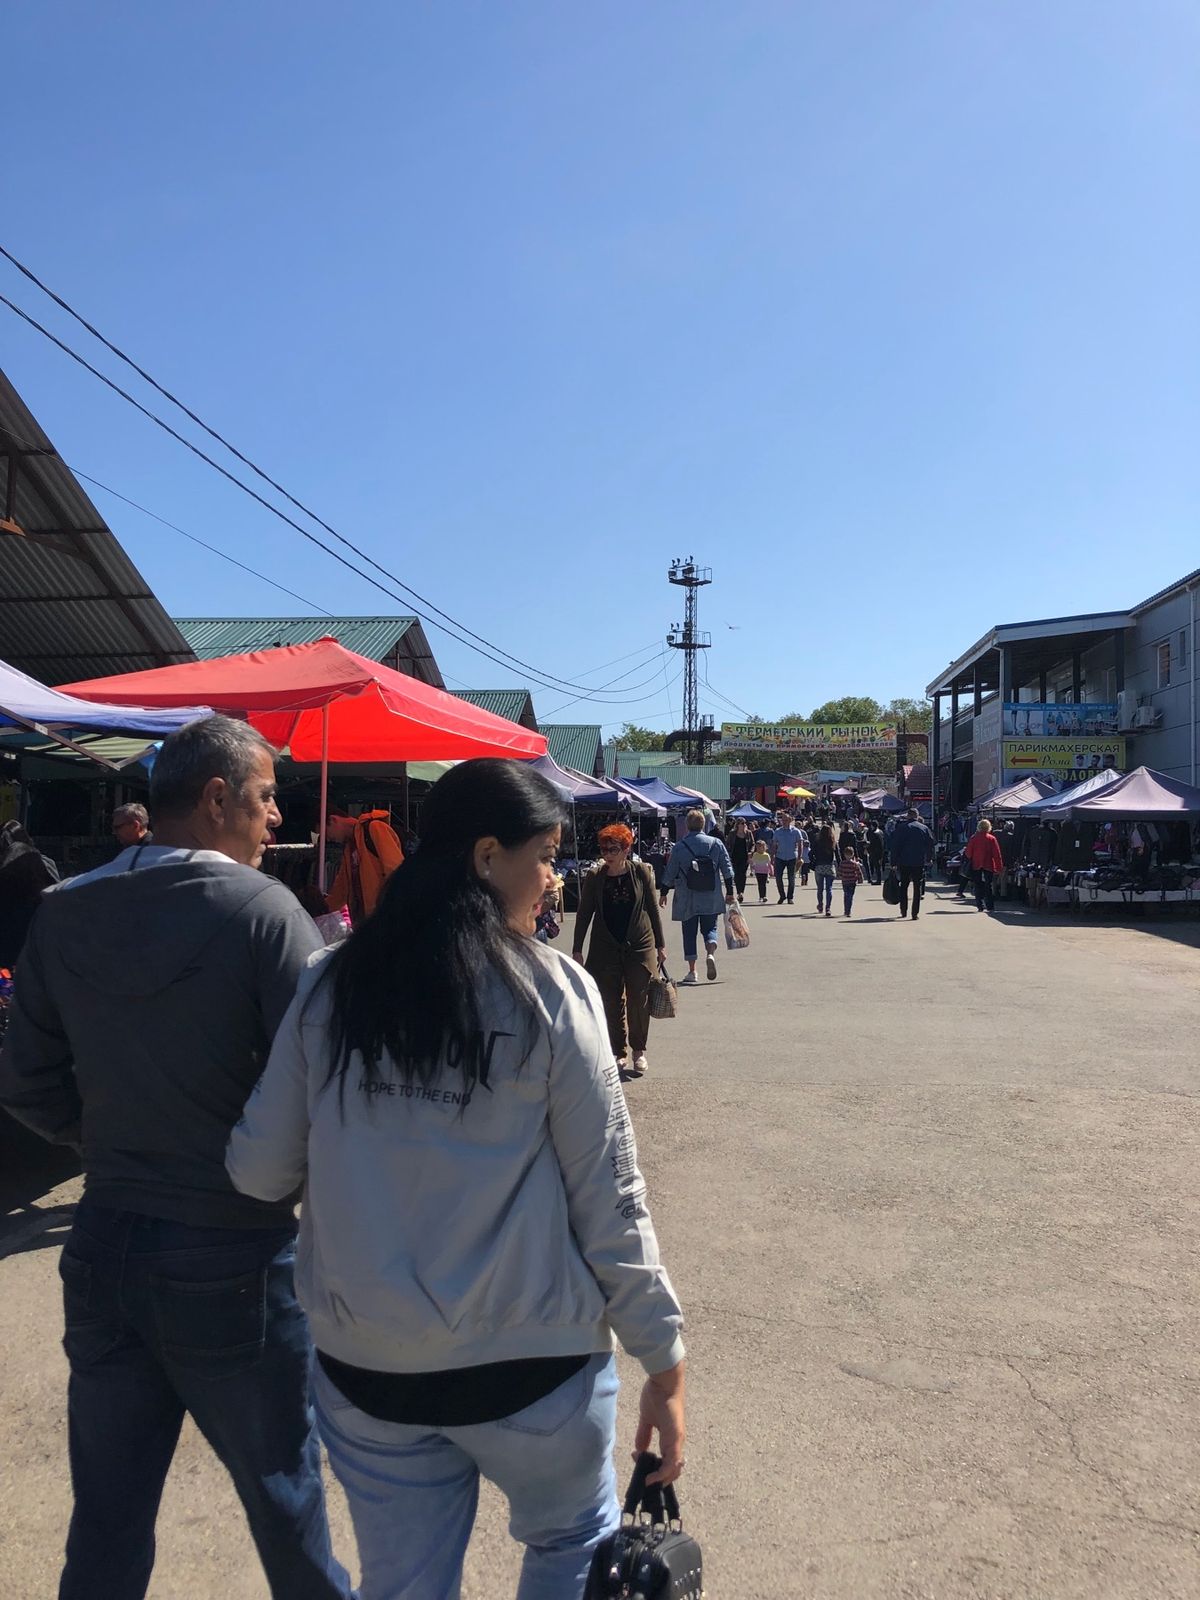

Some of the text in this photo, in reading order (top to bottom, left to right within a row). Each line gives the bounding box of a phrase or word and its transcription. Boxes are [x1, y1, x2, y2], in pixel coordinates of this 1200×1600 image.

[735, 726, 879, 738] ФЕРМЕРСКИЙ РЫНОК
[1009, 744, 1120, 753] ПАРИКМАХЕРСКАЯ
[358, 1079, 471, 1106] HOPE TO THE END
